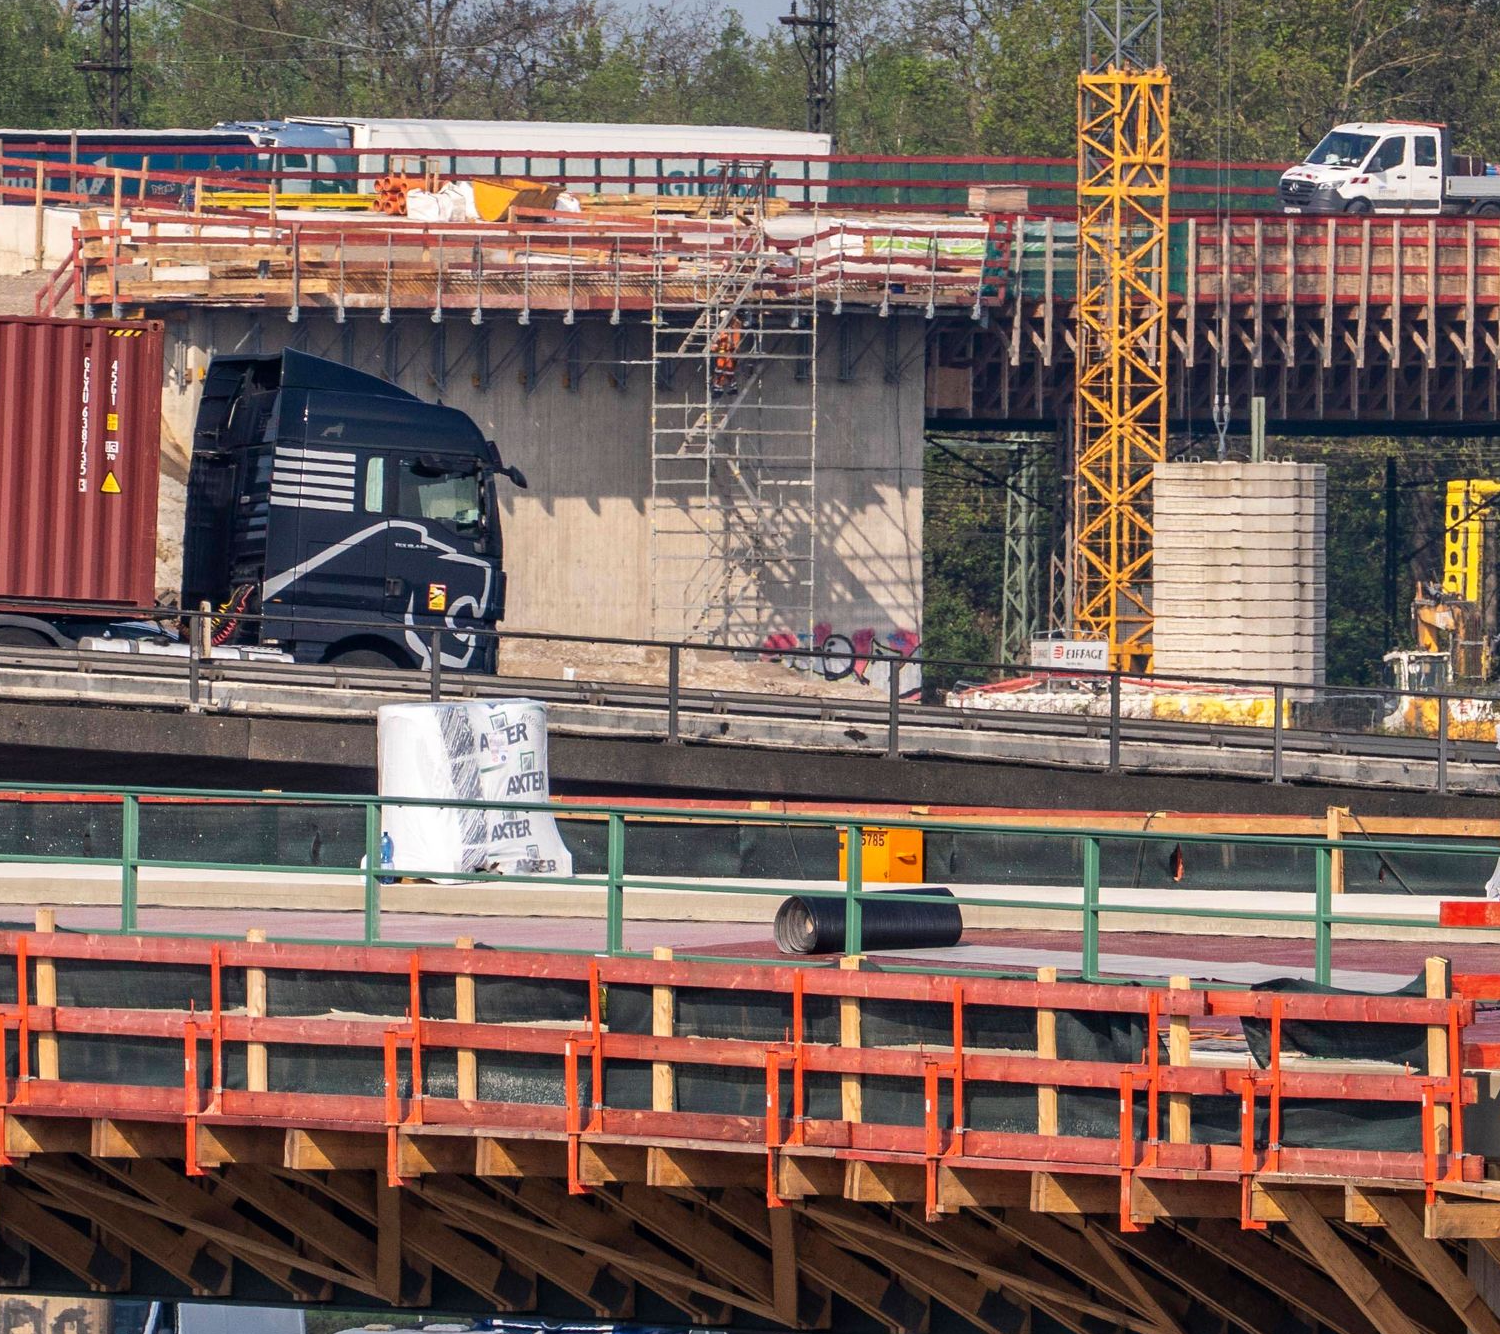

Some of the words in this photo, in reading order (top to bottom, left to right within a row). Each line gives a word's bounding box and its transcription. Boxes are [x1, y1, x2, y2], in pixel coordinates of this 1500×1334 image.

[1066, 649, 1104, 660] EIFFAGE
[480, 722, 529, 753] AER
[506, 771, 546, 798] AXTER
[490, 819, 532, 843] AXTER
